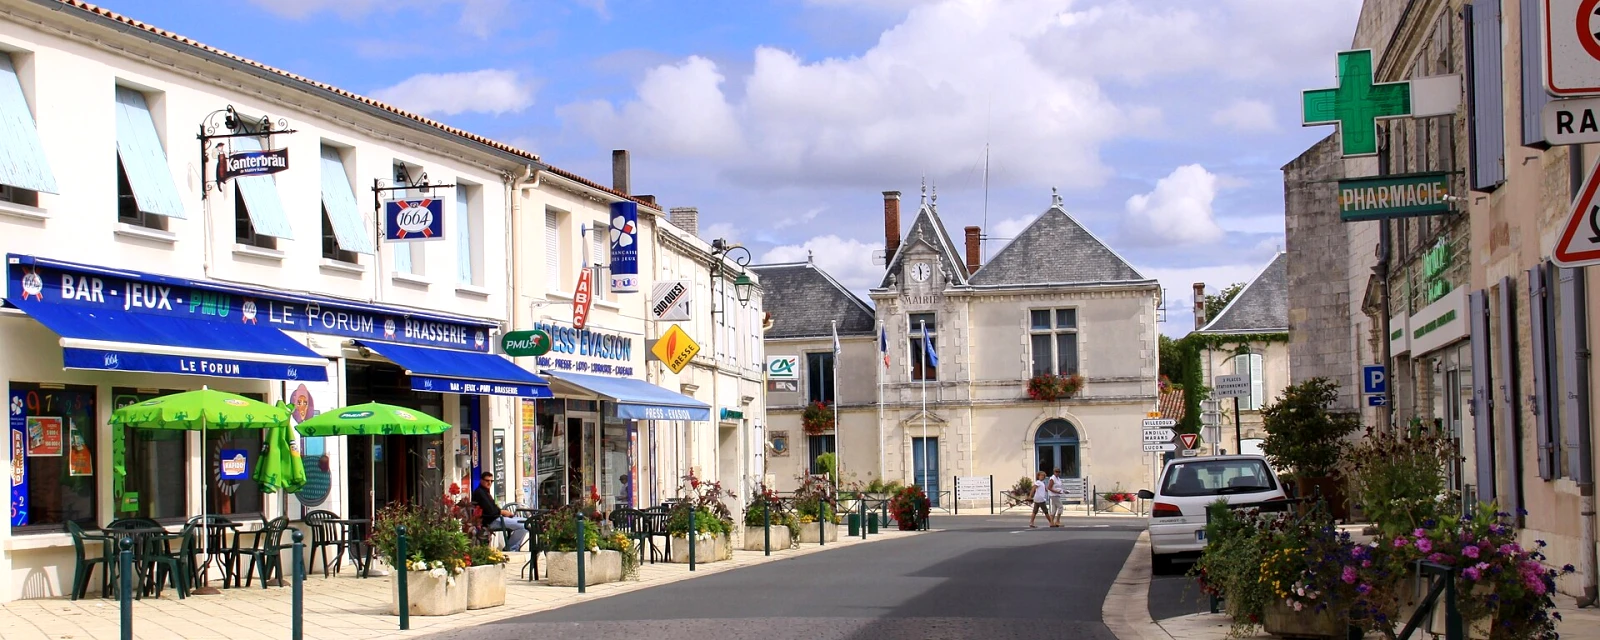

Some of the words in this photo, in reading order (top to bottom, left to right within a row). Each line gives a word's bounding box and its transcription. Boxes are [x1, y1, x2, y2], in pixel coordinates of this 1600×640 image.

[227, 154, 286, 172] Kanterbräu
[1342, 181, 1442, 212] PHARMACIE
[399, 208, 432, 226] 1664
[611, 278, 638, 288] LOTO
[61, 273, 105, 303] BAR
[124, 281, 172, 311] JEUX
[189, 290, 231, 317] PMU
[573, 269, 590, 326] TABAC
[653, 299, 669, 317] SUD
[664, 281, 686, 304] OUEST
[904, 295, 939, 304] MAIRIE
[269, 301, 295, 325] LE
[308, 306, 373, 334] FORUM
[405, 318, 467, 345] BRASSERIE
[506, 339, 529, 350] PMU
[671, 344, 695, 371] PRESSE
[180, 359, 196, 372] LE
[201, 361, 240, 375] FORUM
[1371, 370, 1384, 388] P
[450, 382, 460, 391] BAR
[464, 384, 477, 393] JEUX
[494, 386, 519, 396] BRASSERIE
[27, 391, 41, 416] 9
[645, 407, 665, 419] PRESS
[668, 409, 692, 420] EVASION
[19, 496, 25, 507] 2
[18, 510, 27, 526] 7
